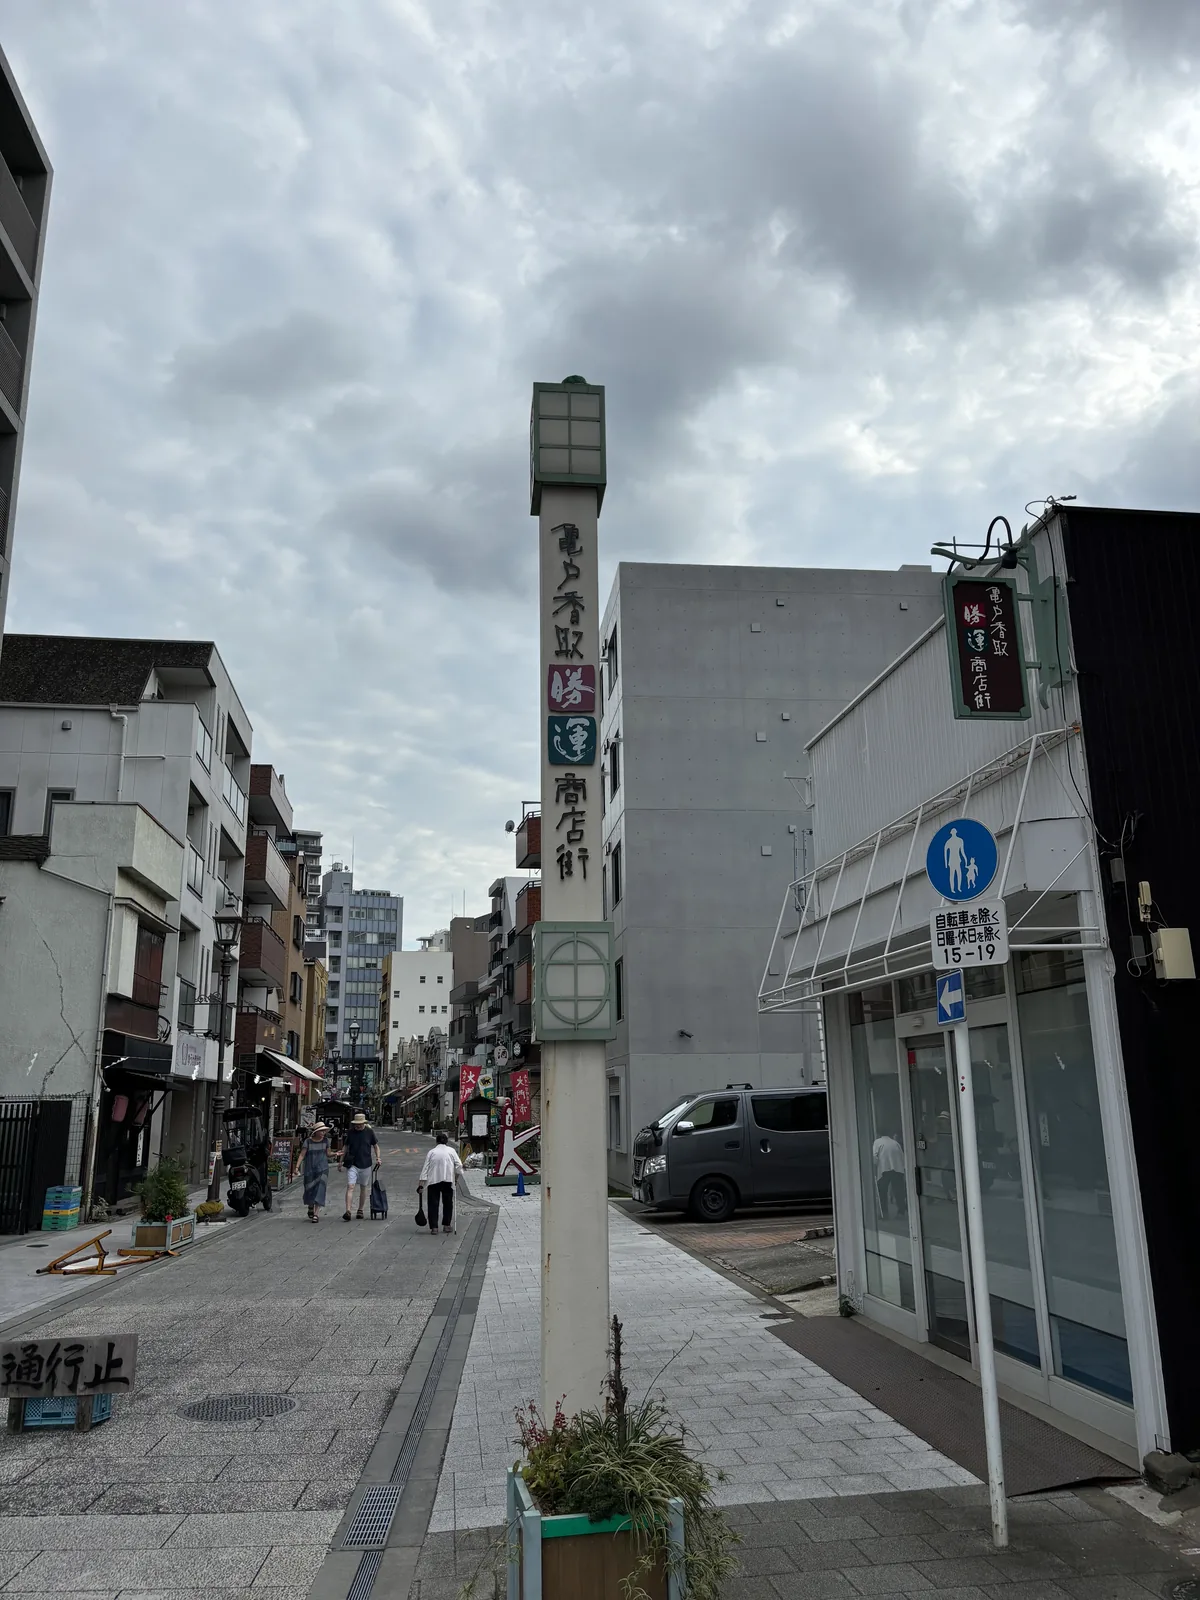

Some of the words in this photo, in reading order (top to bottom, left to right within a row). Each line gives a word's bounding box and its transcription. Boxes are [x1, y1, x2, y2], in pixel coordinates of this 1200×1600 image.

[985, 586, 1010, 657] 亀戸香取
[935, 908, 1000, 929] 自転車を除く
[943, 943, 996, 965] 15-19
[1, 1341, 130, 1393] 通行止
